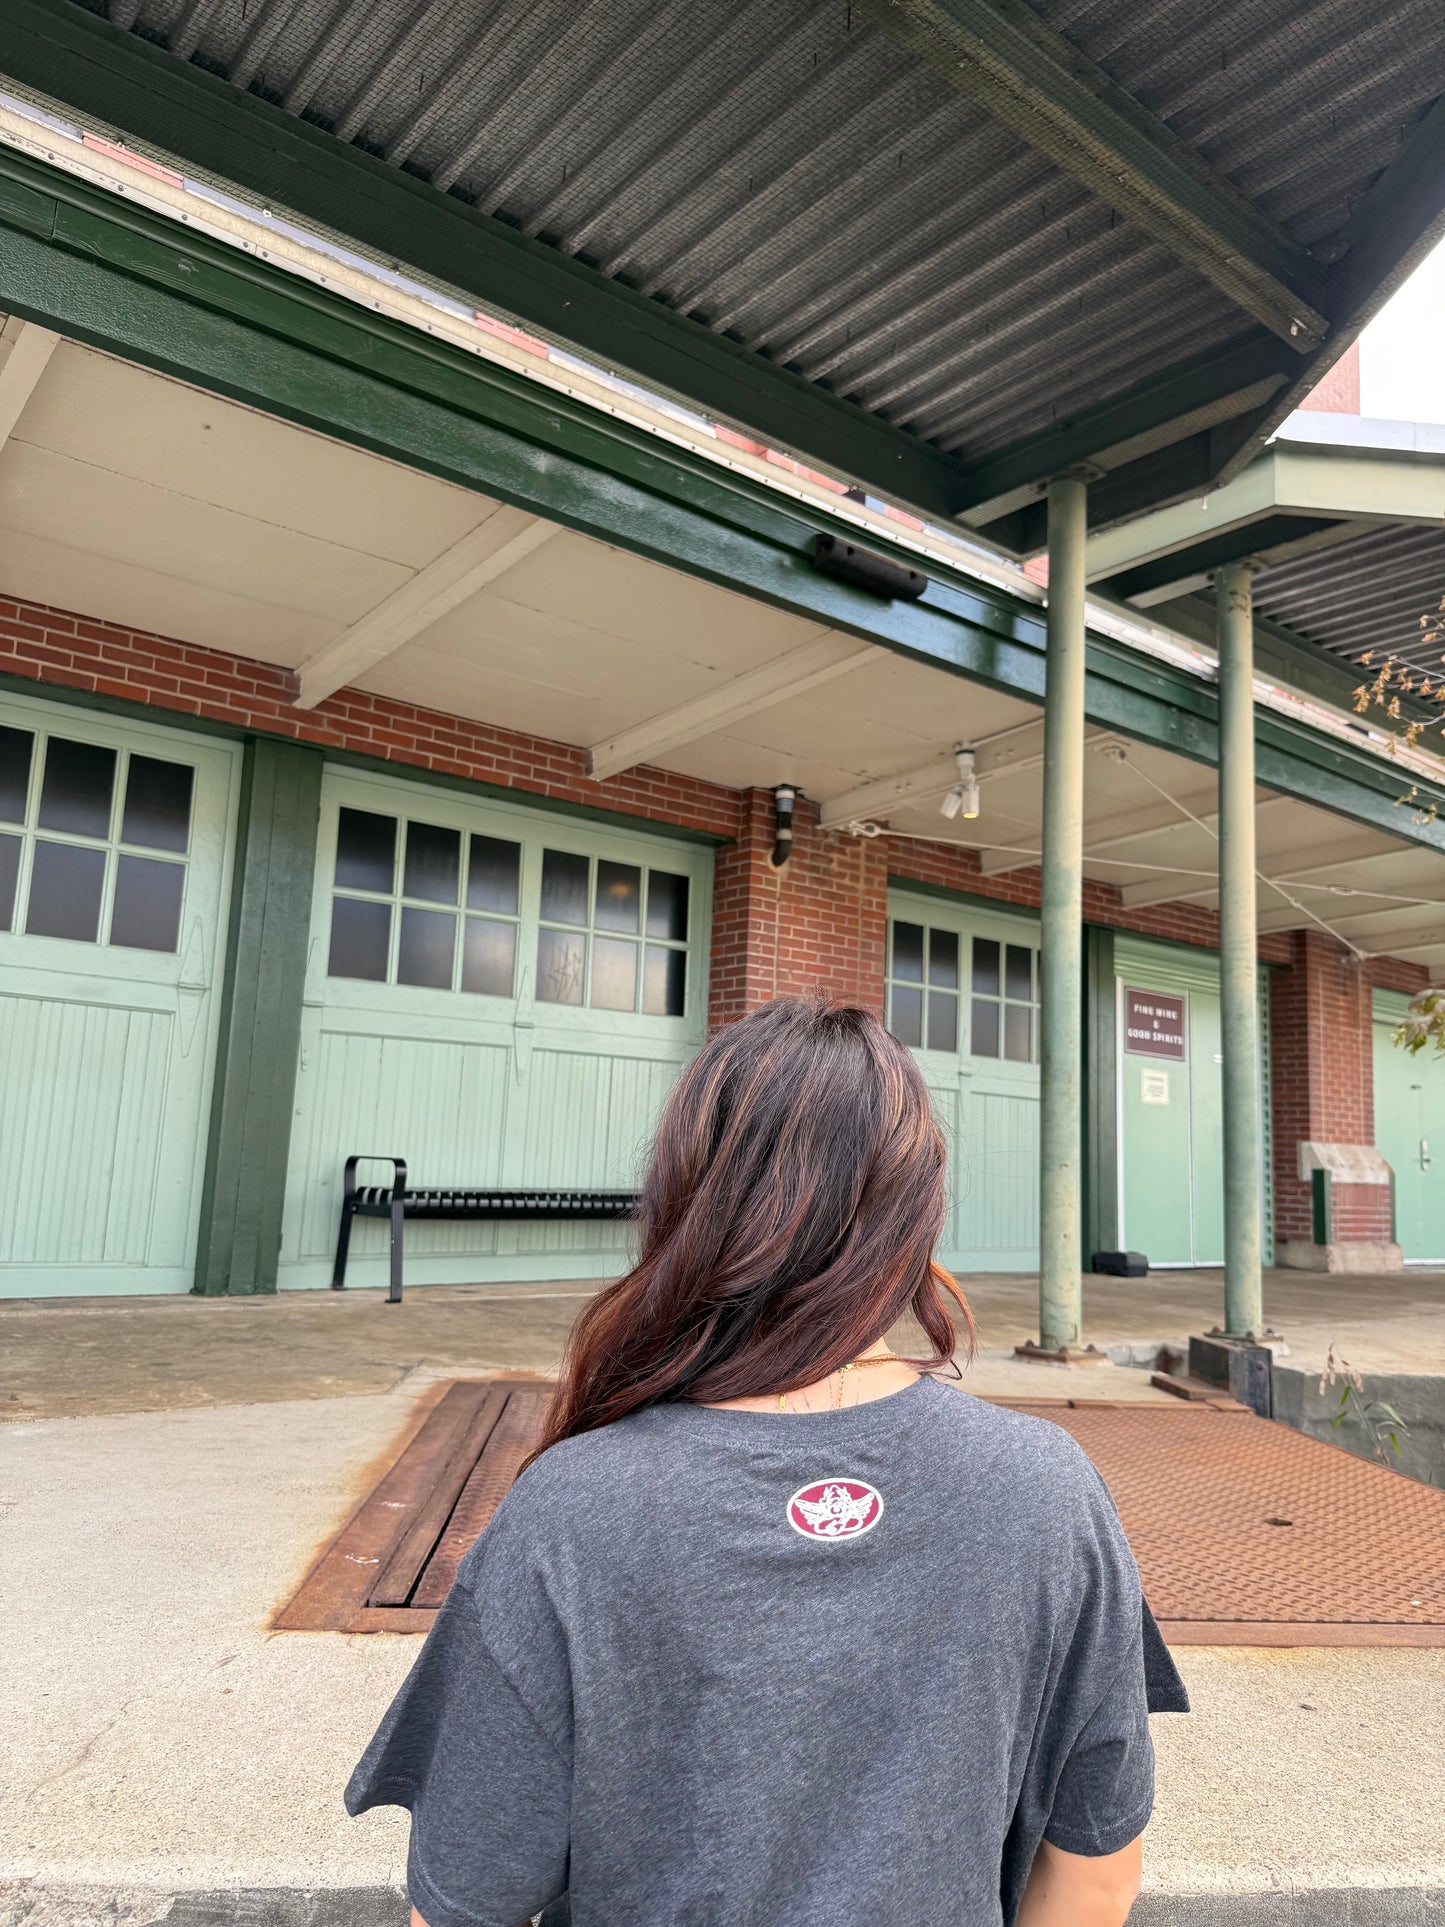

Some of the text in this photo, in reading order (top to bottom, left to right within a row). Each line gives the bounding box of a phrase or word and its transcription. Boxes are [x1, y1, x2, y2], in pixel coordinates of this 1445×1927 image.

[1133, 1003, 1178, 1020] FINE WINE
[1127, 1028, 1184, 1045] GOOD SPIRITS
